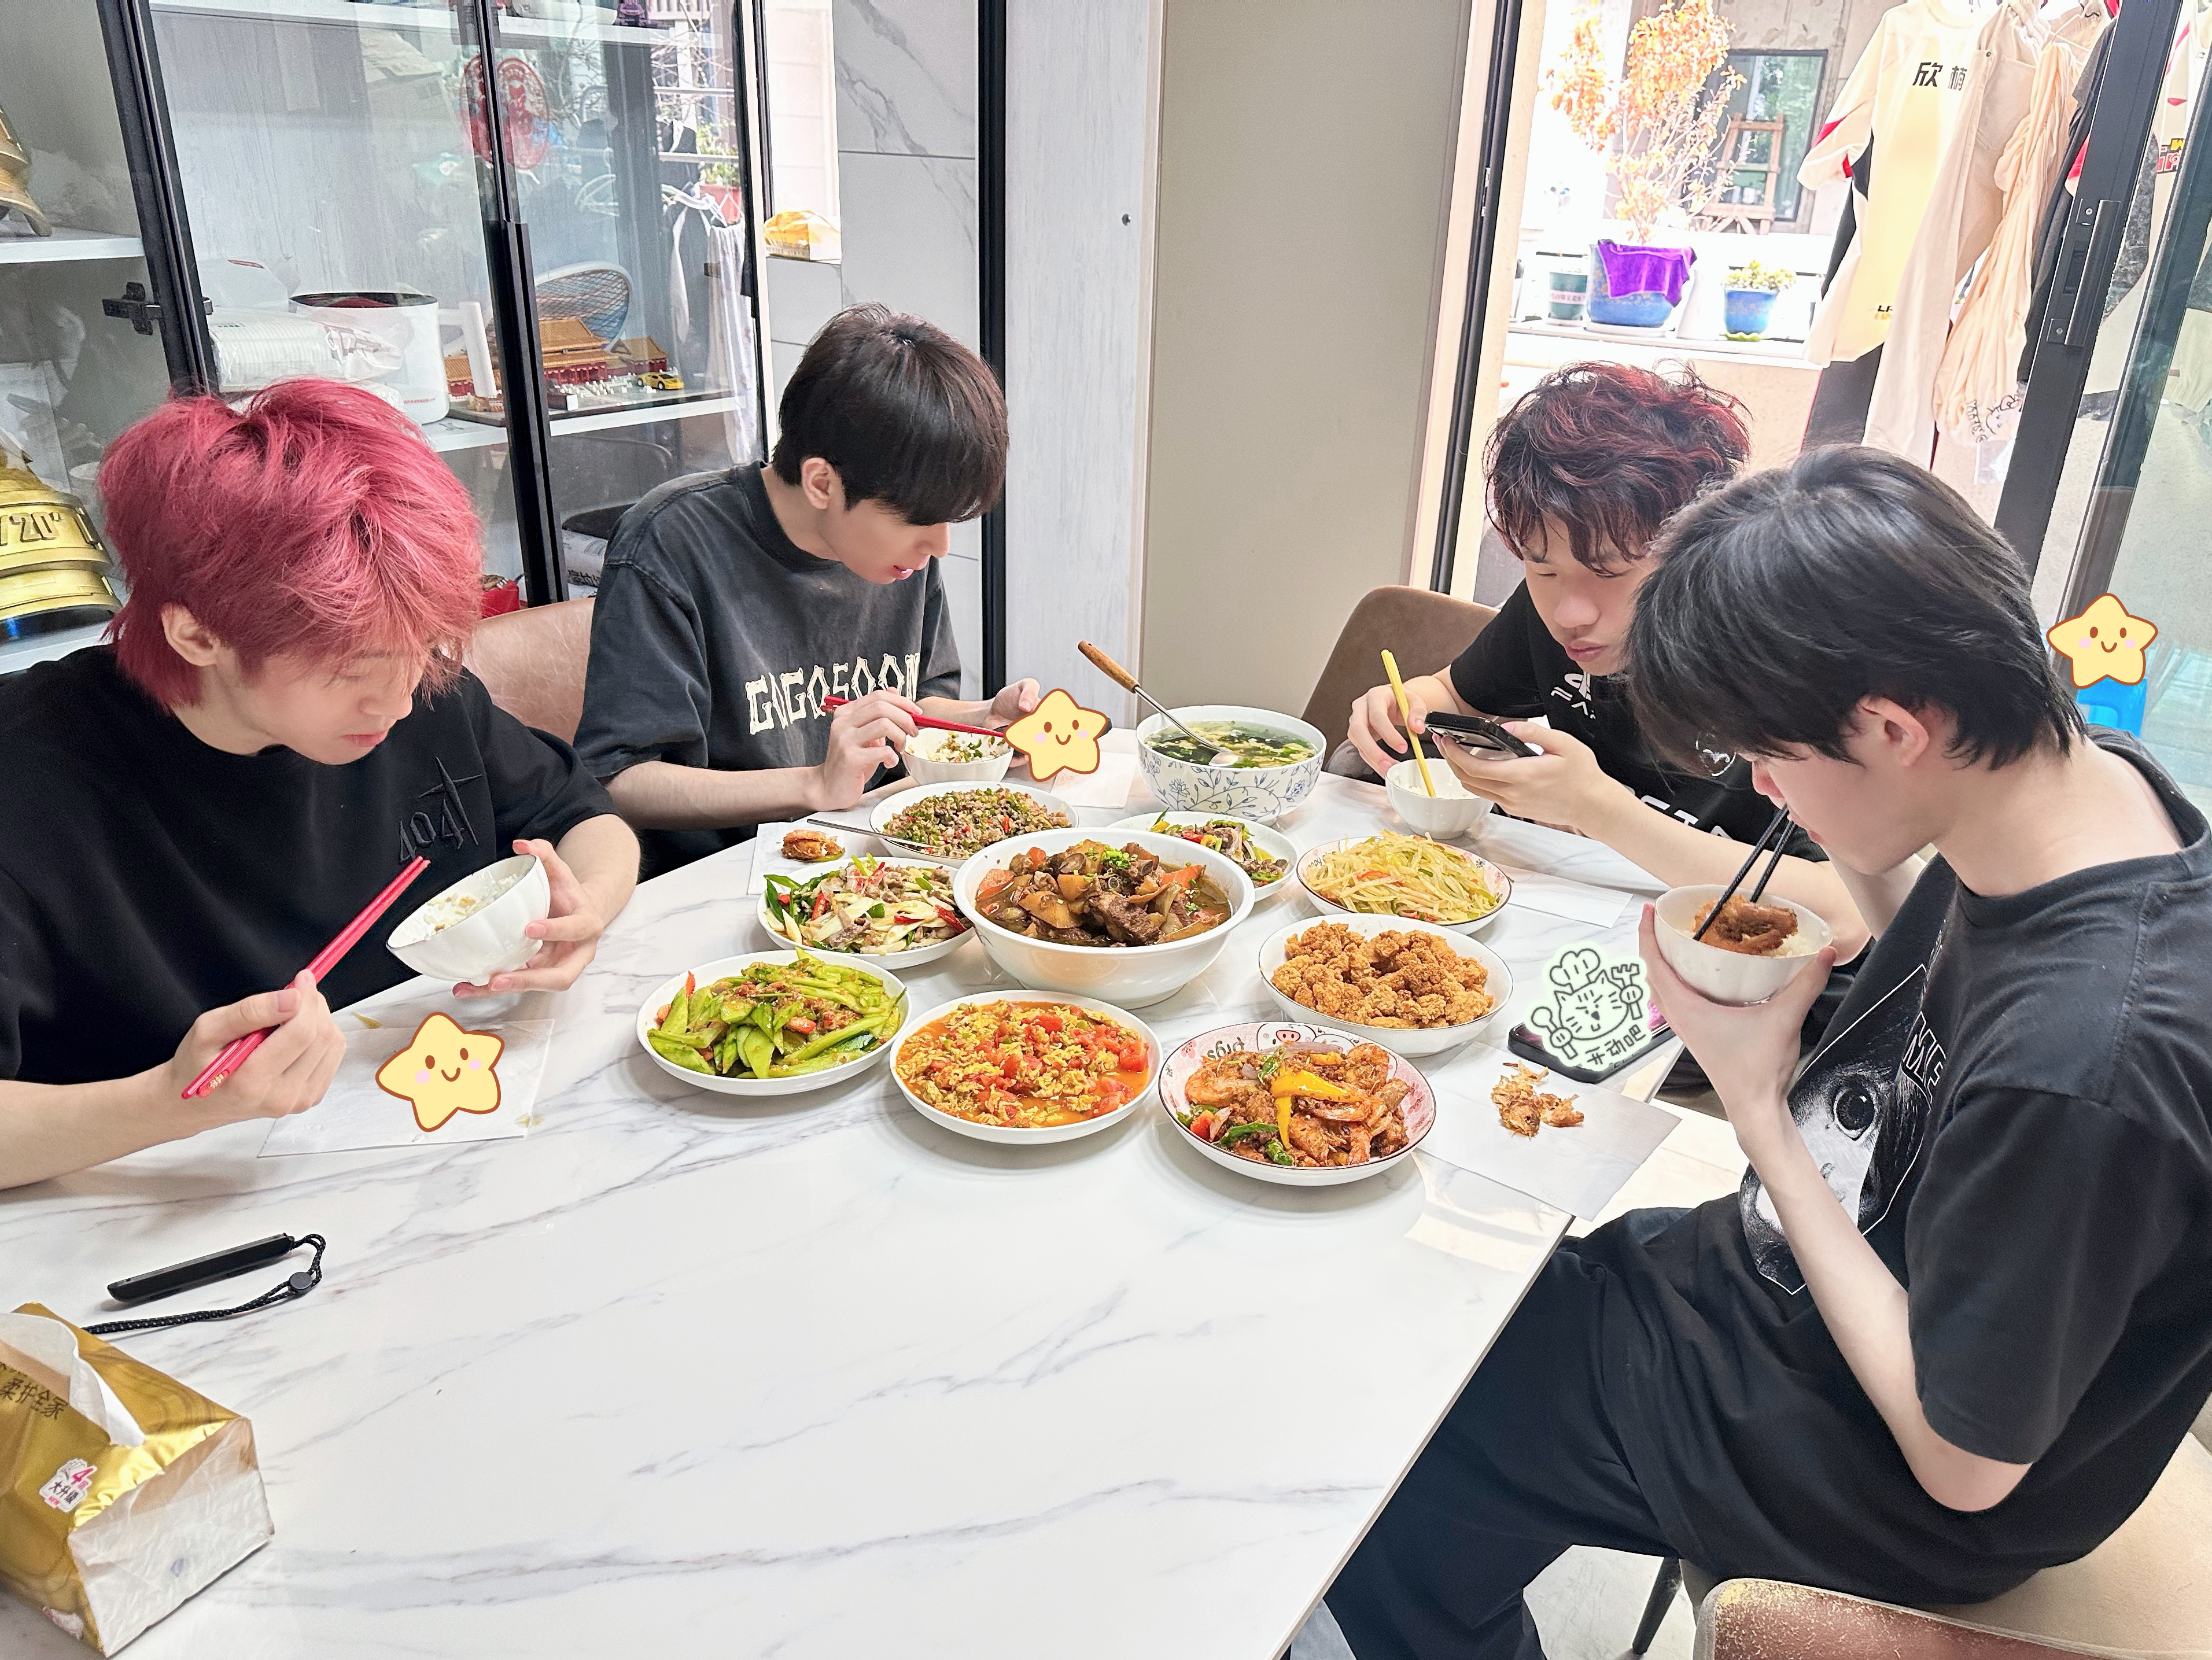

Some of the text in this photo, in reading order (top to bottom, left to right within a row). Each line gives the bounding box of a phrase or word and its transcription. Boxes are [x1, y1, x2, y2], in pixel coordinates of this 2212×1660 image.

[0, 1377, 68, 1420] 柔护全家
[48, 1480, 79, 1504] 大升级
